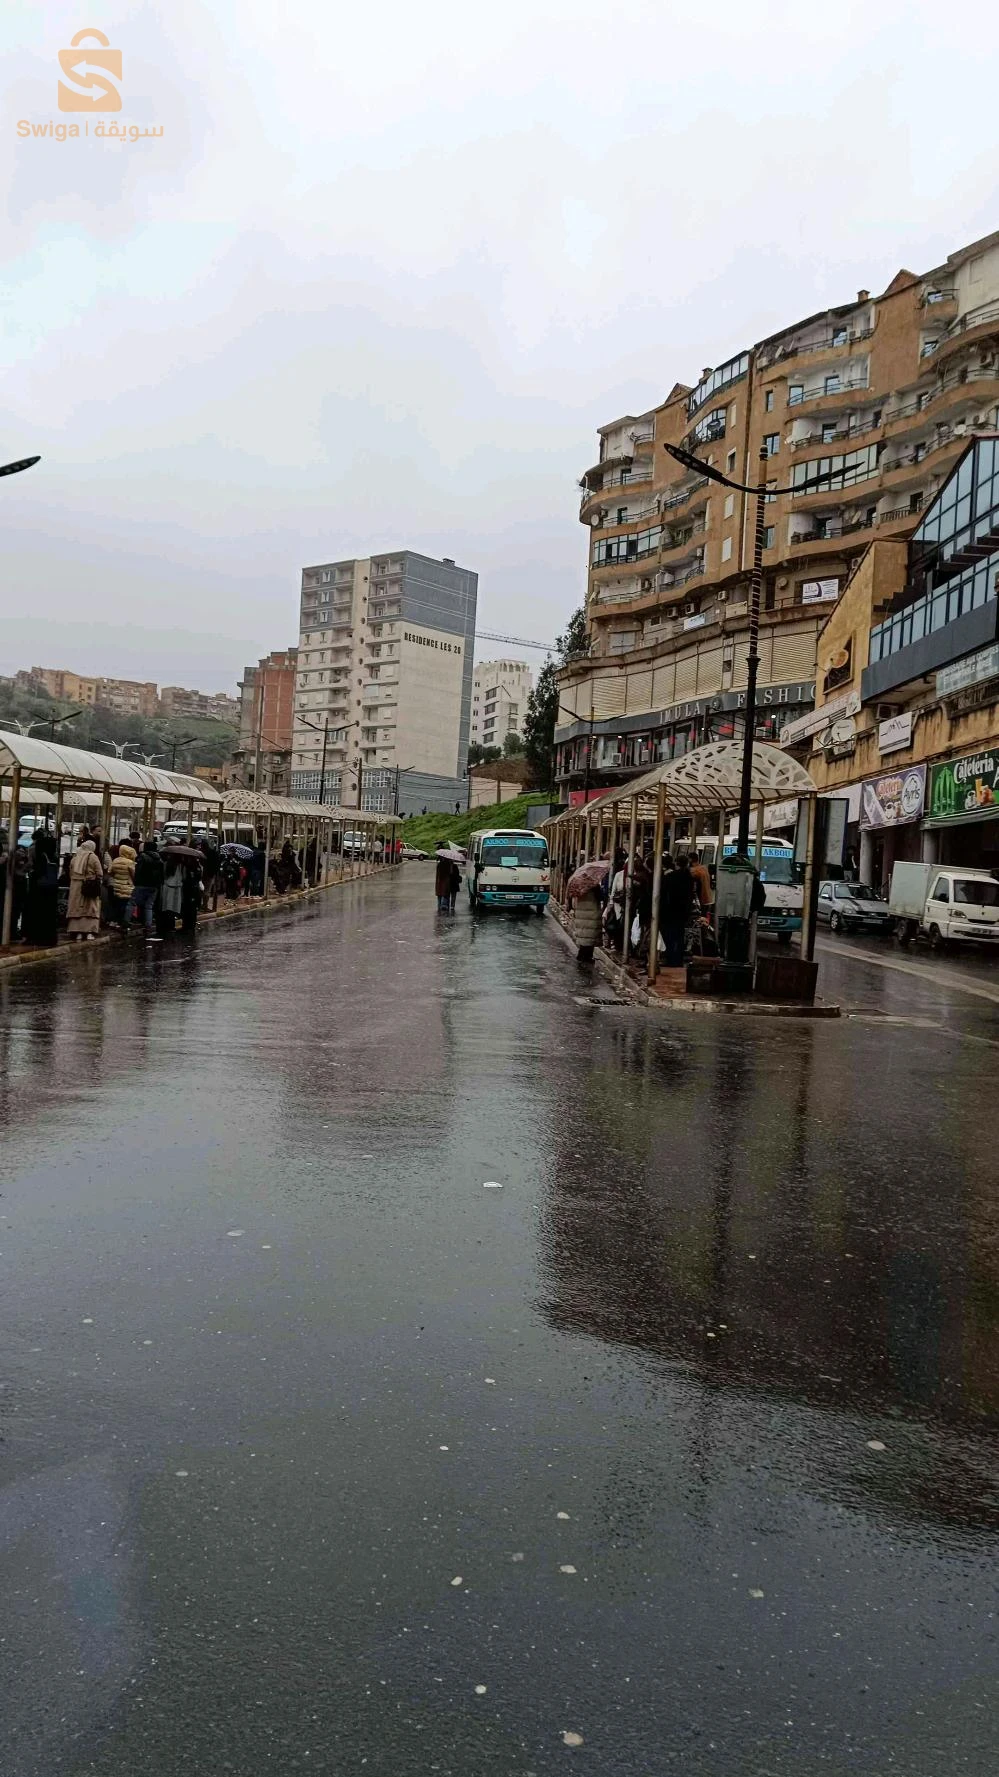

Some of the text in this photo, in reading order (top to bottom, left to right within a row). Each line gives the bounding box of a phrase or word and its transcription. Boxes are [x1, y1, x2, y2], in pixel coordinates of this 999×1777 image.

[404, 632, 438, 648] RESIDENCE
[440, 641, 452, 652] LES
[737, 685, 816, 709] FSHI
[763, 848, 791, 858] AKBOU
